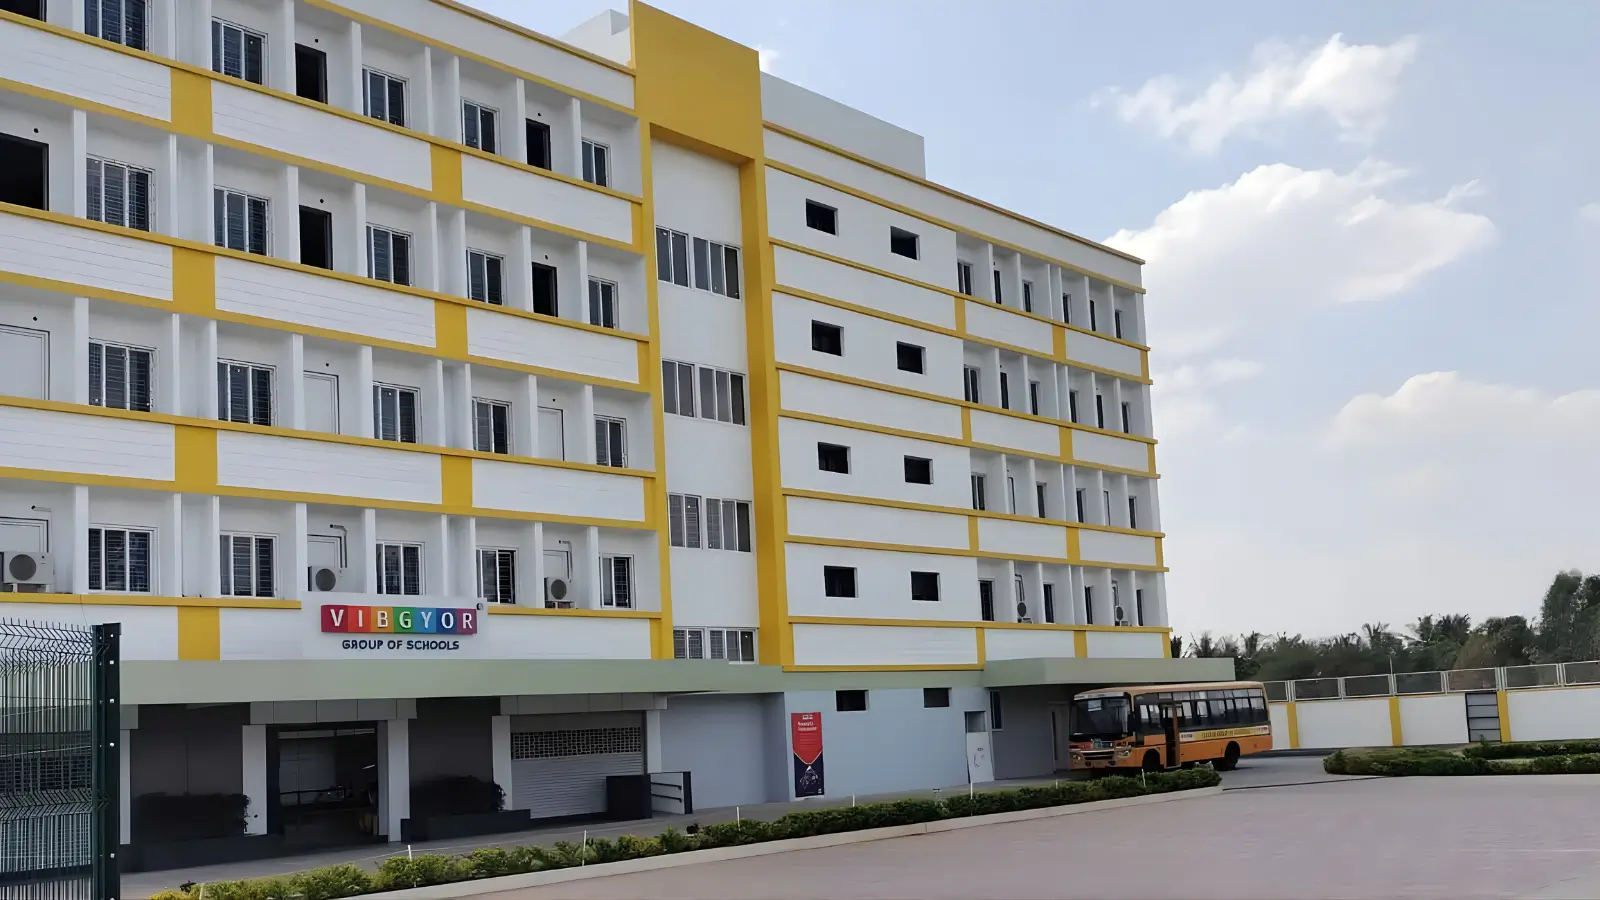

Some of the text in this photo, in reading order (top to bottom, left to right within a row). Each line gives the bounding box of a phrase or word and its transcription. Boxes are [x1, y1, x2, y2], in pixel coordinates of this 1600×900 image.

[330, 609, 473, 630] VIBGYOR
[342, 639, 460, 651] GROUP OF SCHOOLS
